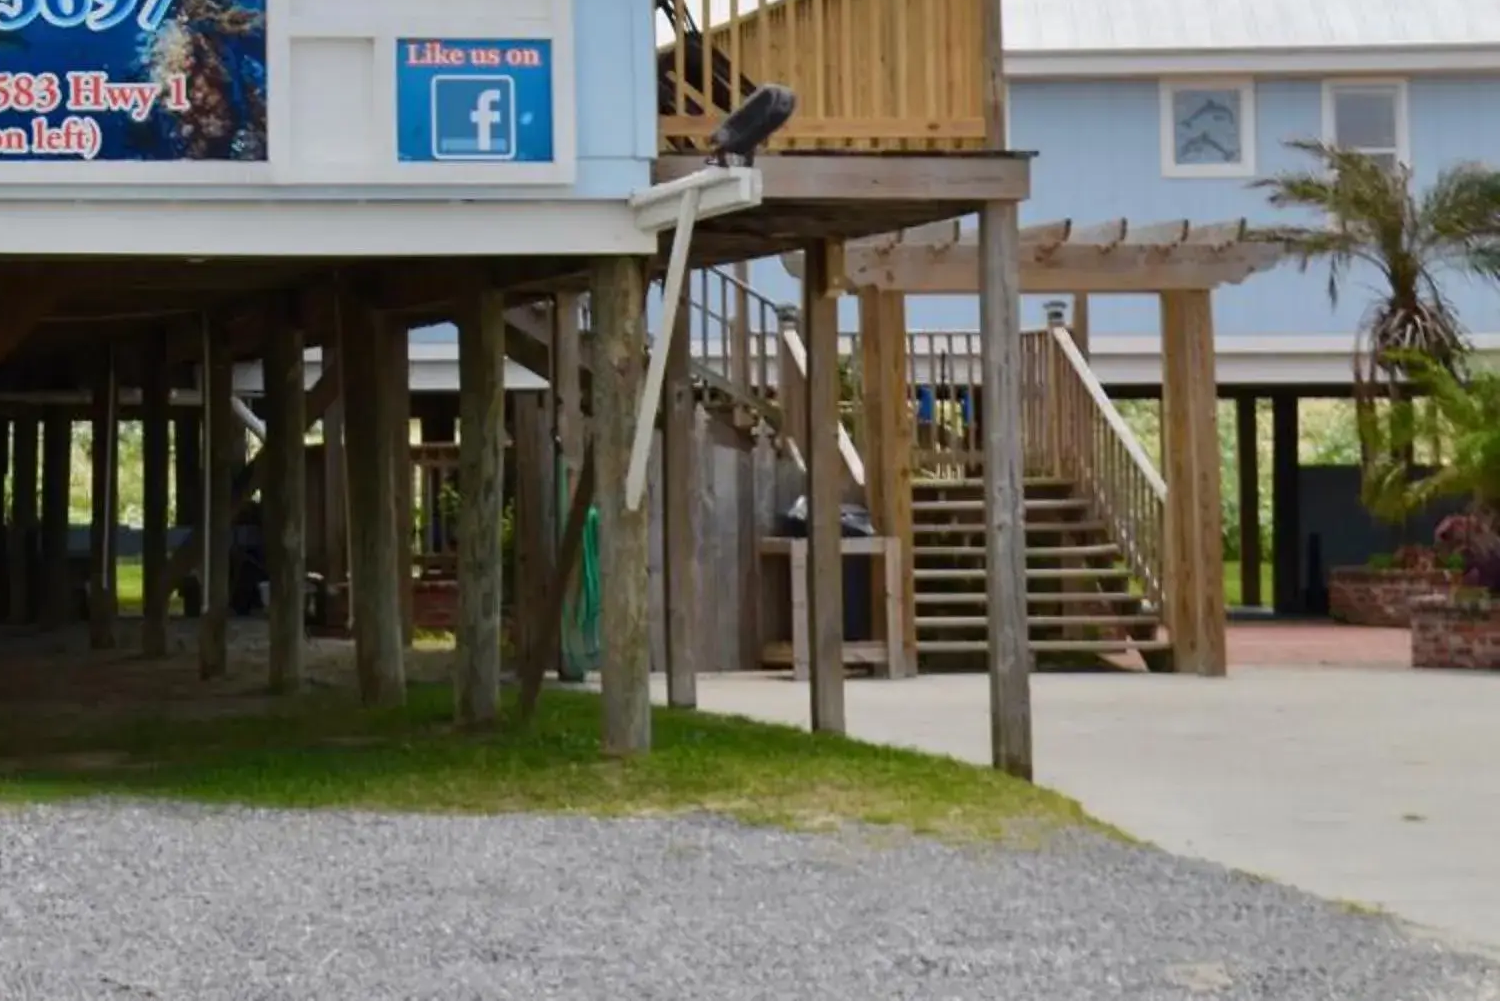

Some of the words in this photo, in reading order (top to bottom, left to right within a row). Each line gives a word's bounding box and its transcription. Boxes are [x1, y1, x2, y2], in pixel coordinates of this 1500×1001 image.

[406, 42, 465, 65] Like
[471, 47, 500, 66] us
[506, 48, 541, 66] on
[69, 74, 158, 118] Hwy
[169, 73, 189, 109] 1
[32, 118, 102, 158] left)
